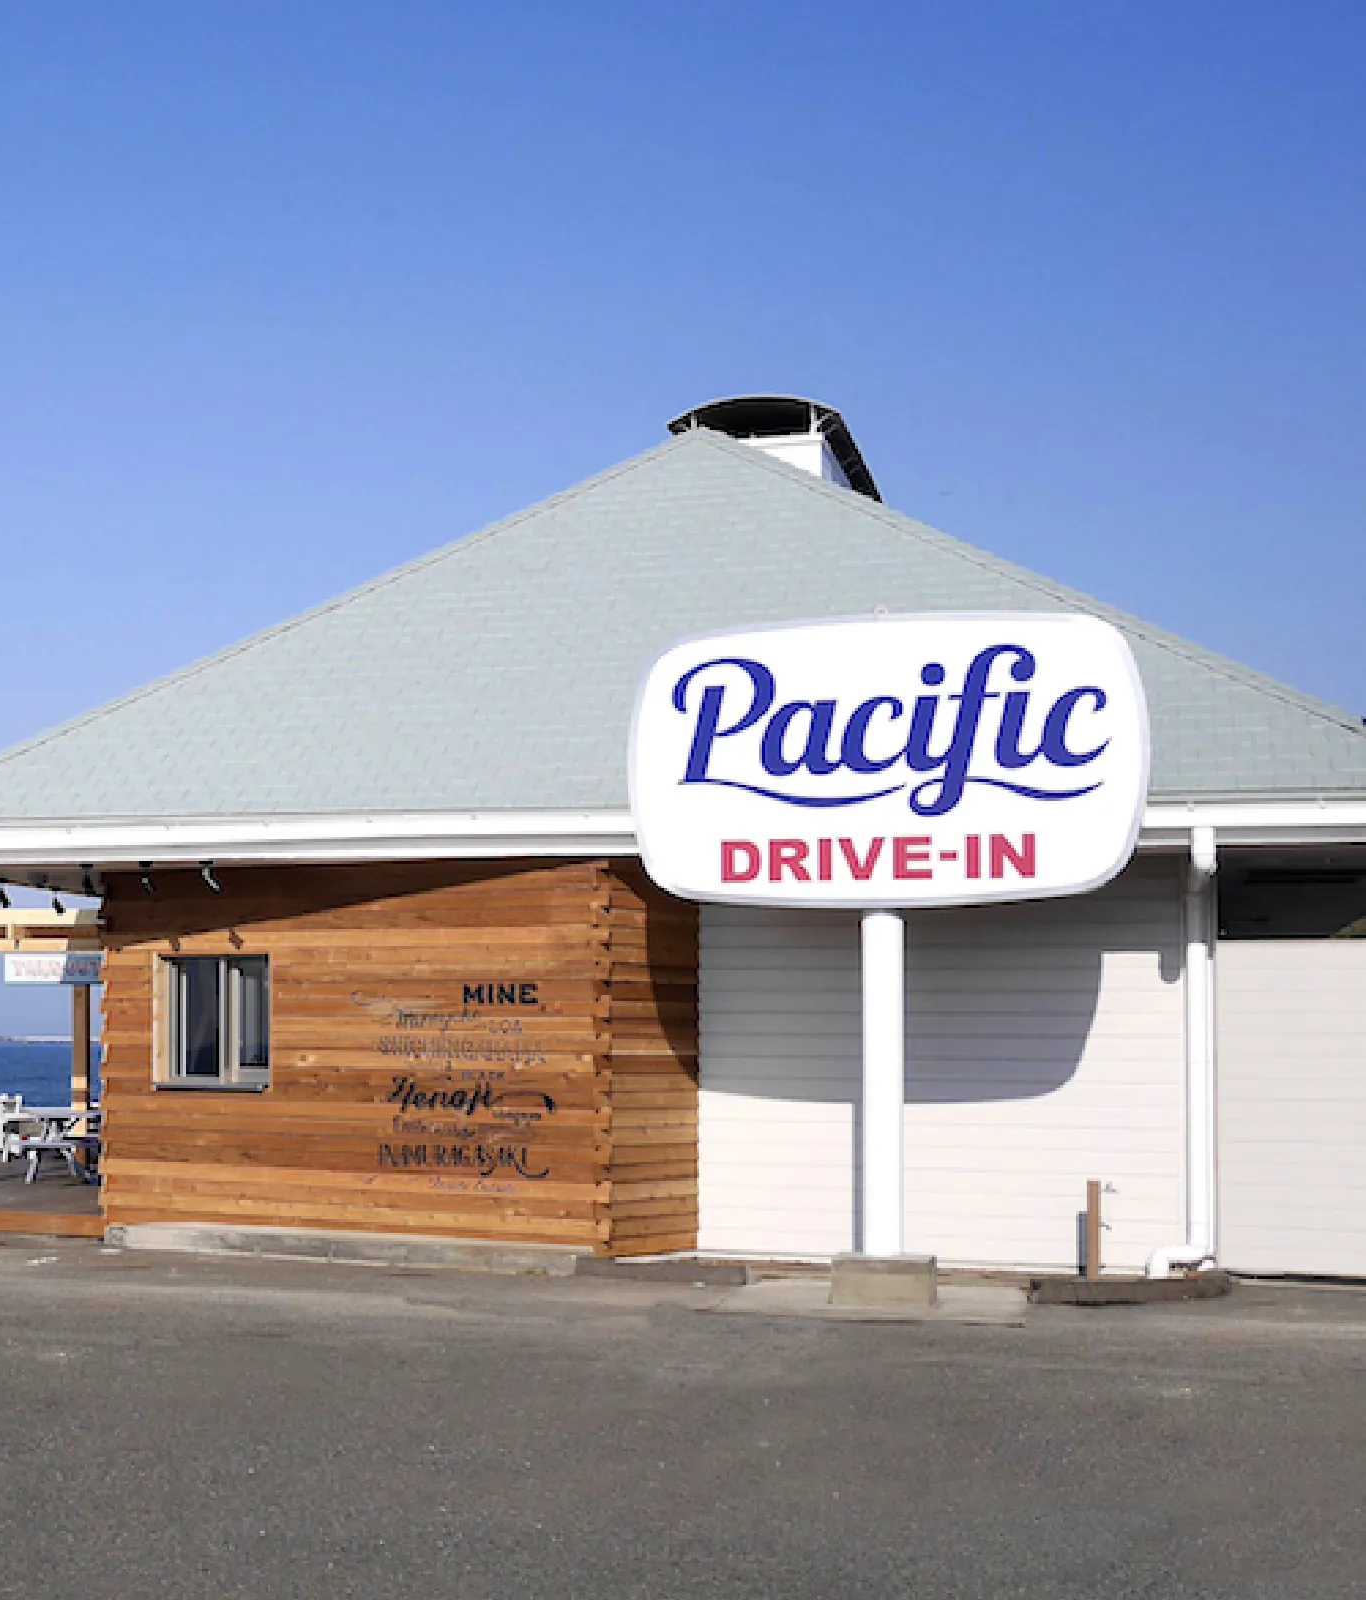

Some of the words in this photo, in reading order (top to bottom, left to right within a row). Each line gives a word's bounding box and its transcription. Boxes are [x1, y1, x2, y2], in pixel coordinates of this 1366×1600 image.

[672, 644, 1112, 816] Pacific
[721, 833, 1036, 883] DRIVE-IN
[463, 984, 538, 1003] MINE
